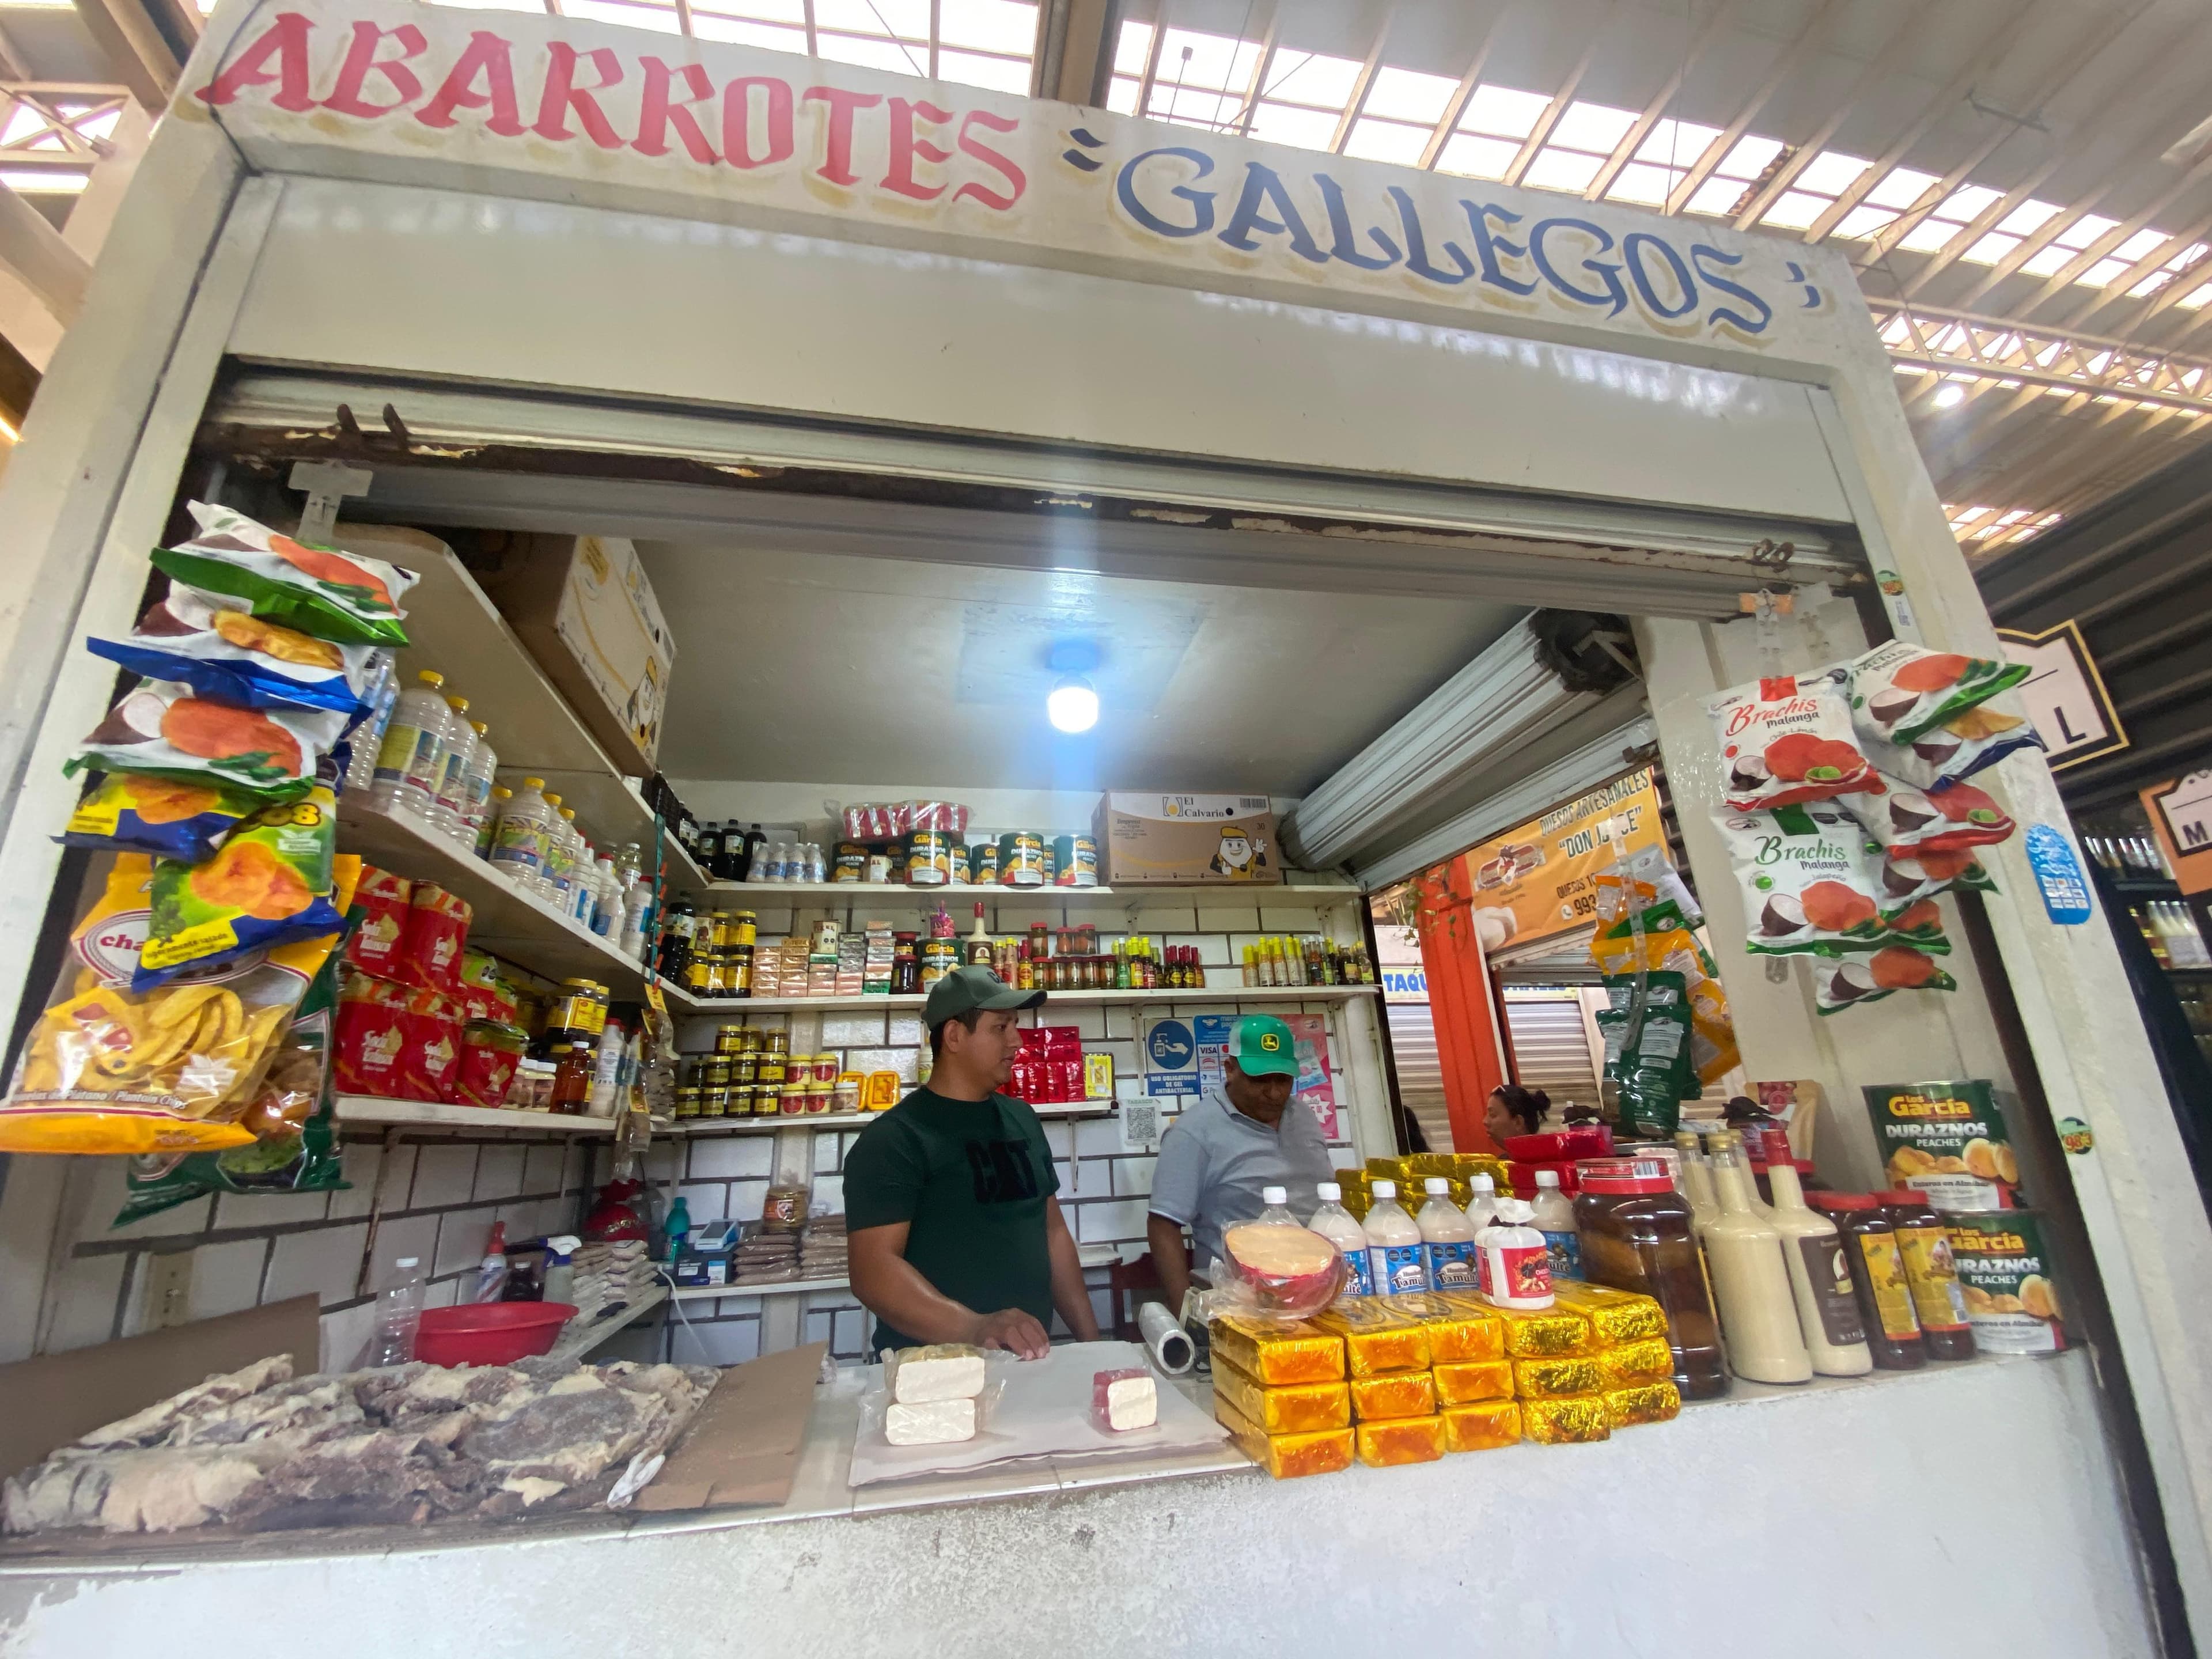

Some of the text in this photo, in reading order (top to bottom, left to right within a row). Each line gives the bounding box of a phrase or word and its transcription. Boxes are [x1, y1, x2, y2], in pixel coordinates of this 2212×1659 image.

[195, 12, 1027, 211] ABARROTES
[1116, 146, 1773, 334] GALLEGOS
[1725, 699, 1817, 737] Brachis
[1766, 711, 1820, 729] malanga
[1184, 796, 1194, 805] El
[1184, 808, 1225, 817] Calvario
[1754, 836, 1846, 865] Brachis
[1800, 860, 1850, 871] malanga
[1556, 877, 1586, 899] QUESOS
[1885, 1122, 1988, 1138] DURAZNOS
[1916, 1138, 1961, 1147] PEACHES
[1955, 1256, 2041, 1274] URAZNOS
[1971, 1275, 2017, 1284] PEACHES
